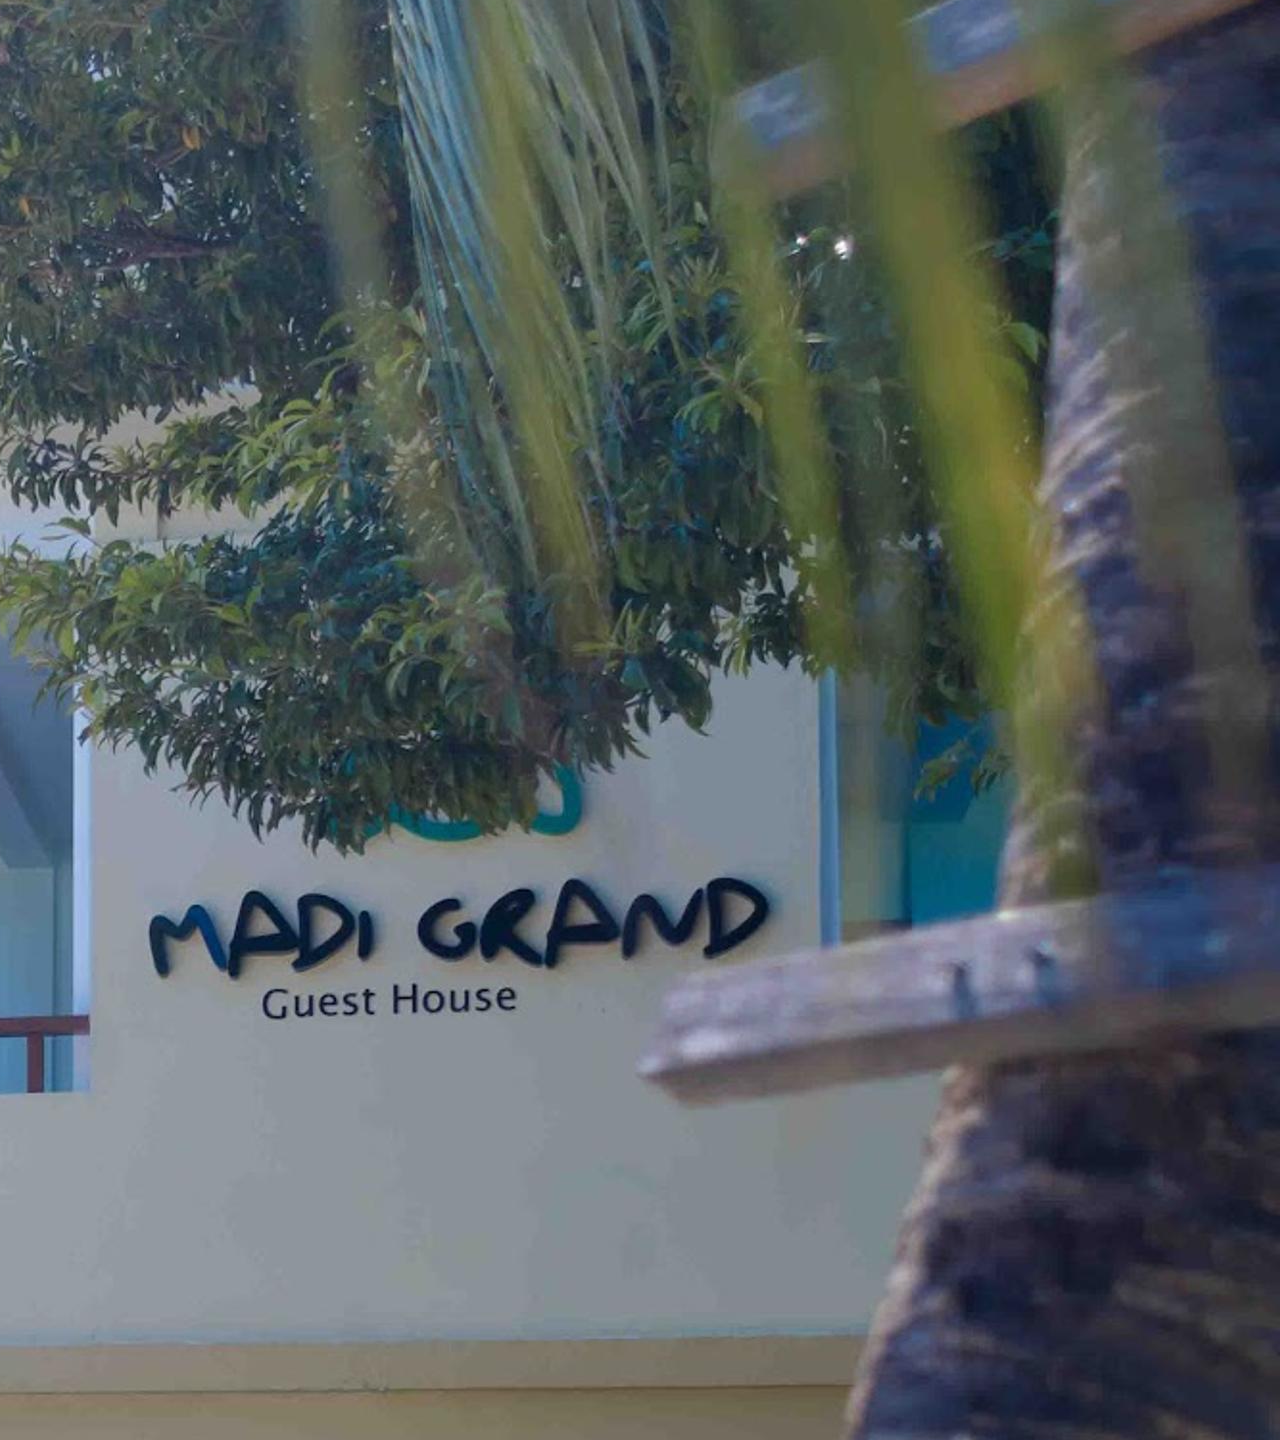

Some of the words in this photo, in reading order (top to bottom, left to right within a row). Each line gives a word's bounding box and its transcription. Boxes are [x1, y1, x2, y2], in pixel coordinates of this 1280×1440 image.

[149, 890, 374, 979] MADI
[417, 877, 770, 970] GRAND
[261, 987, 376, 1020] Guest
[392, 984, 517, 1016] House
